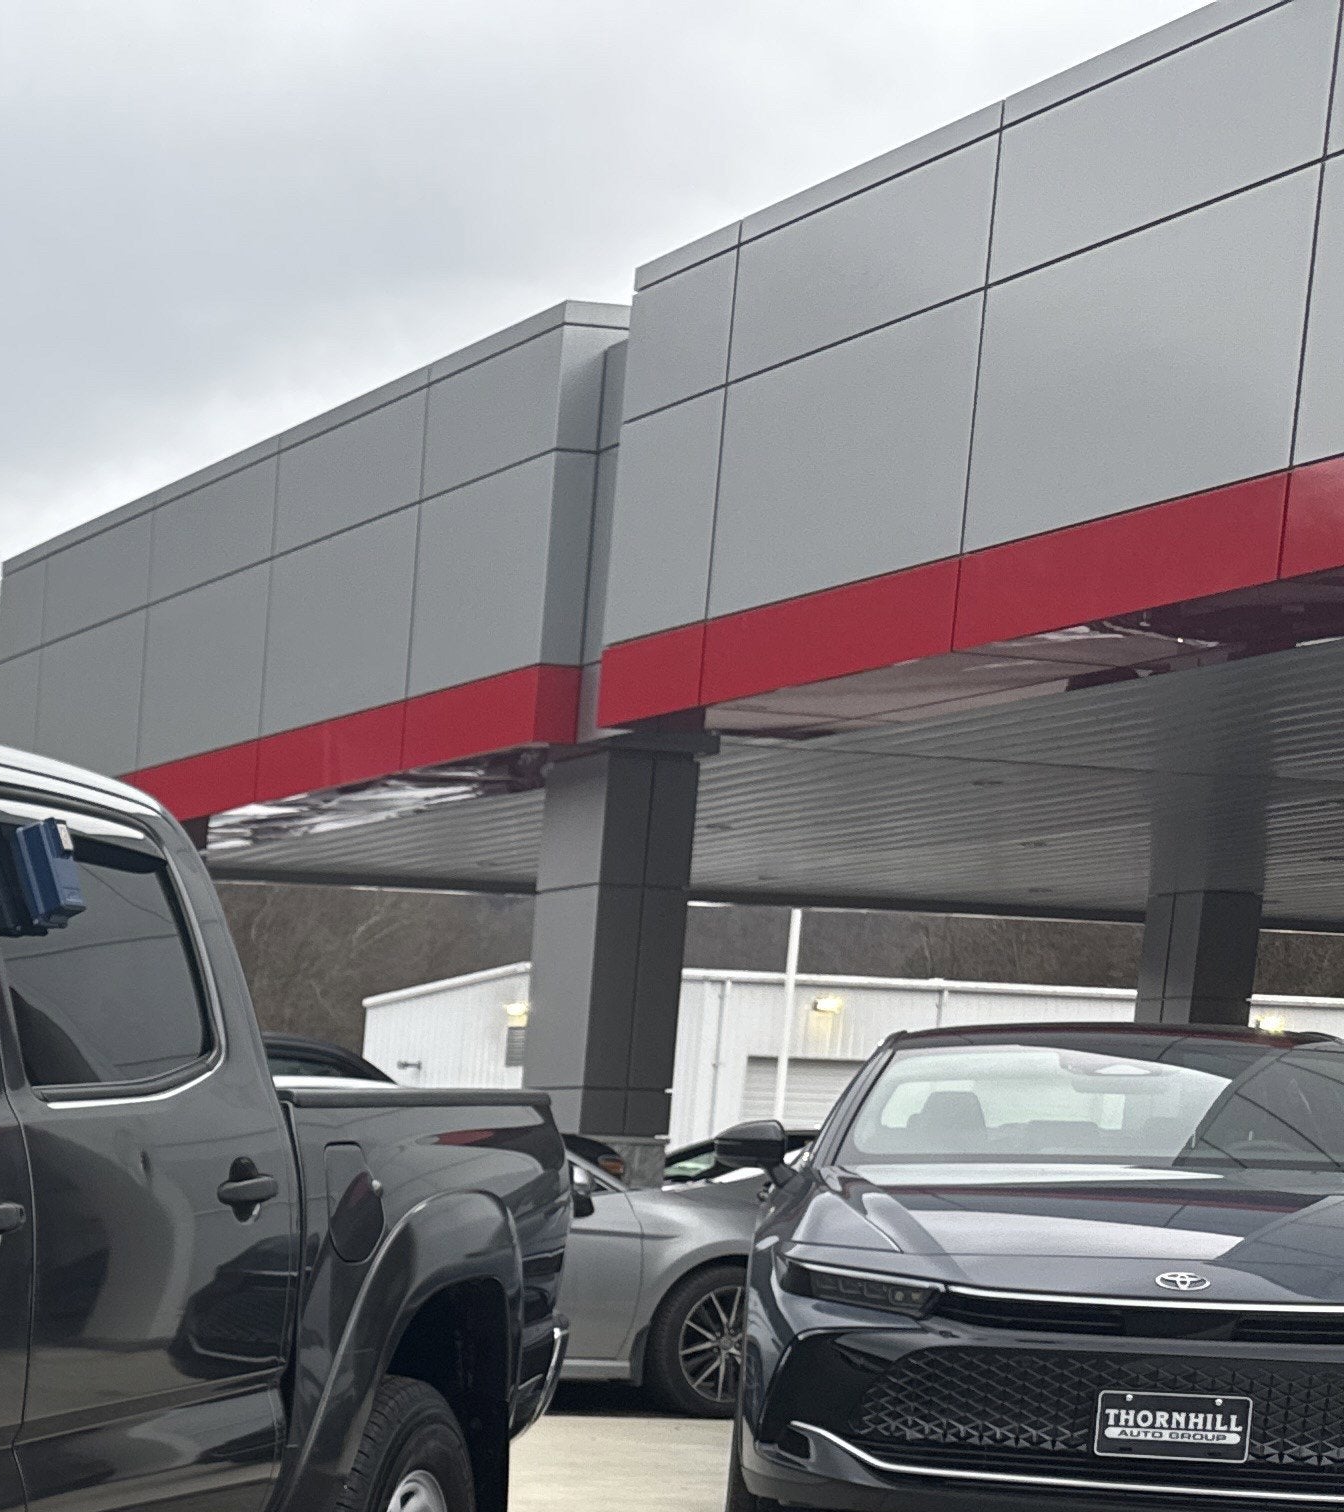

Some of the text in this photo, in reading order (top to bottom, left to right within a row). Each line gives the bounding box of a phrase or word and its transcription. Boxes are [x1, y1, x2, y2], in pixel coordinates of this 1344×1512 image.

[1105, 1408, 1243, 1432] THORNHILL
[1118, 1429, 1227, 1442] AUTO GROUP
